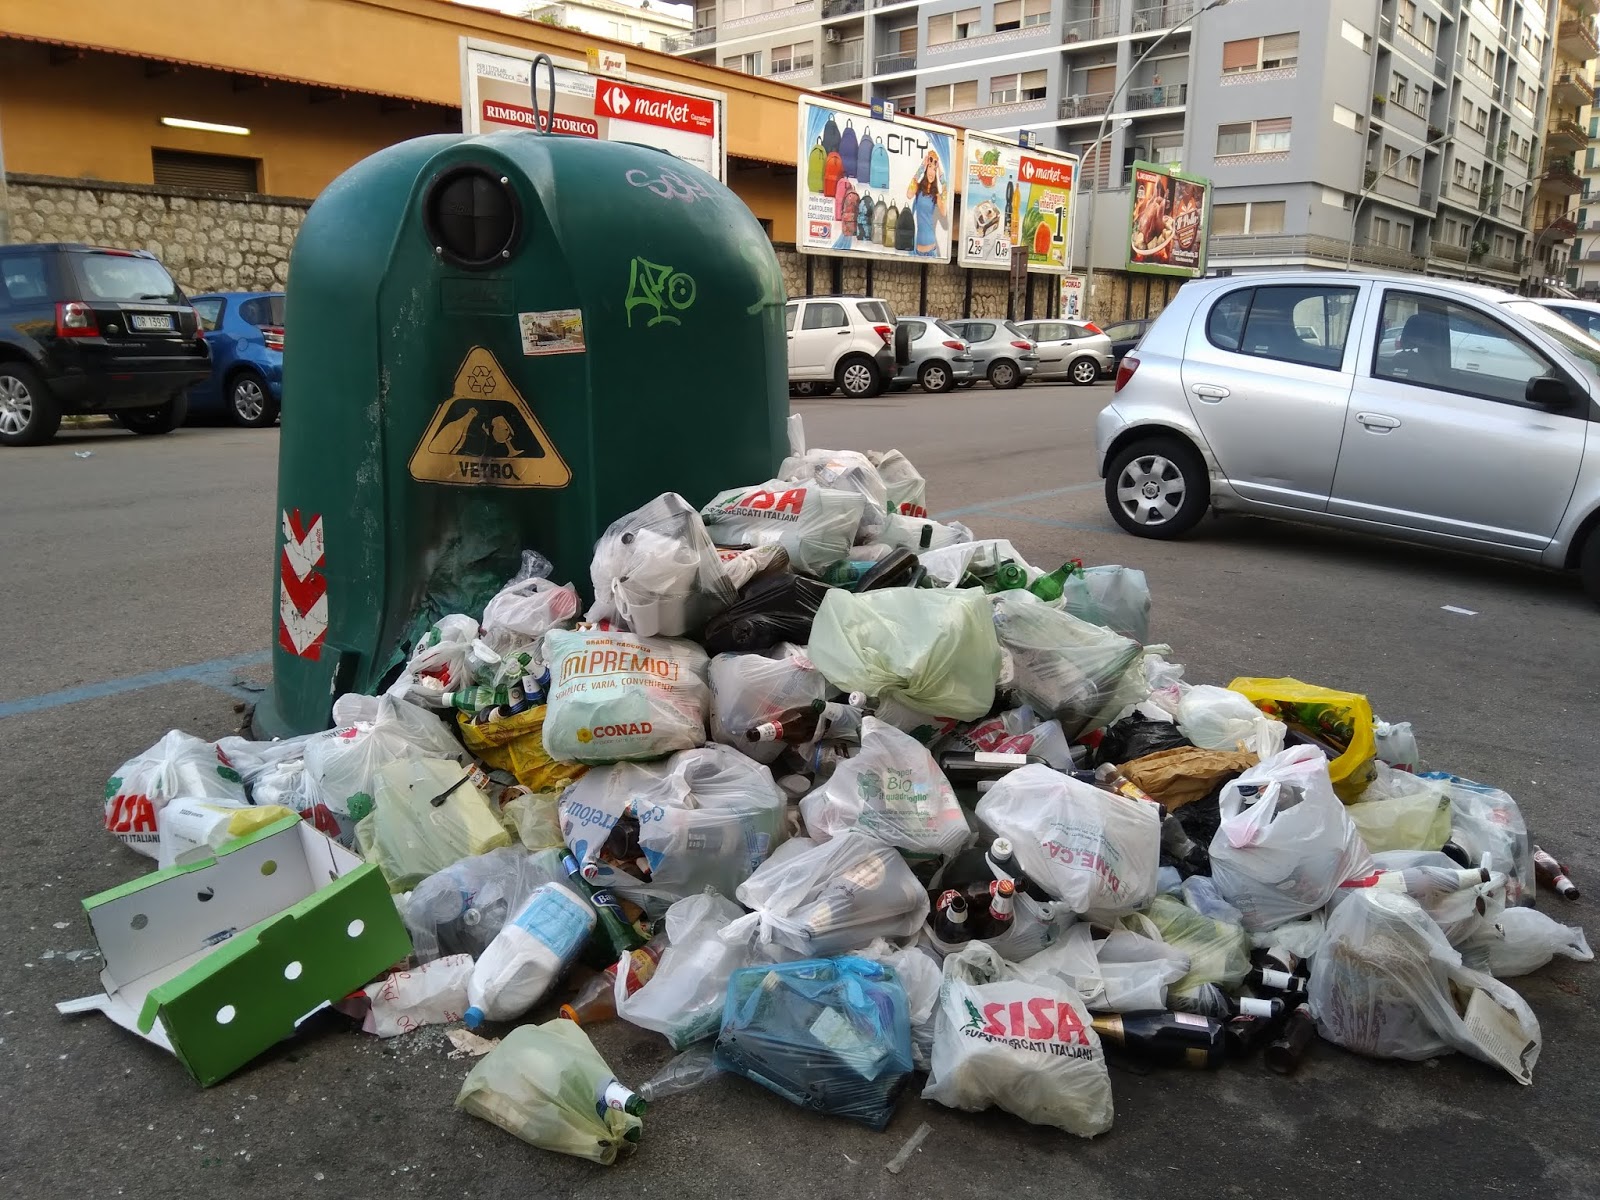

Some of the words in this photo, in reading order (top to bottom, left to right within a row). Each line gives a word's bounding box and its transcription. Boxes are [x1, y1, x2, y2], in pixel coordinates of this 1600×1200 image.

[486, 105, 547, 126] RIMBORSO
[551, 117, 595, 134] STORICO
[634, 98, 689, 124] market
[888, 133, 929, 159] CITY
[1035, 166, 1061, 183] market
[459, 461, 516, 480] VETRO
[593, 722, 653, 738] CONAD
[983, 997, 1090, 1046] SISA
[1050, 1043, 1093, 1061] ITALIANI
